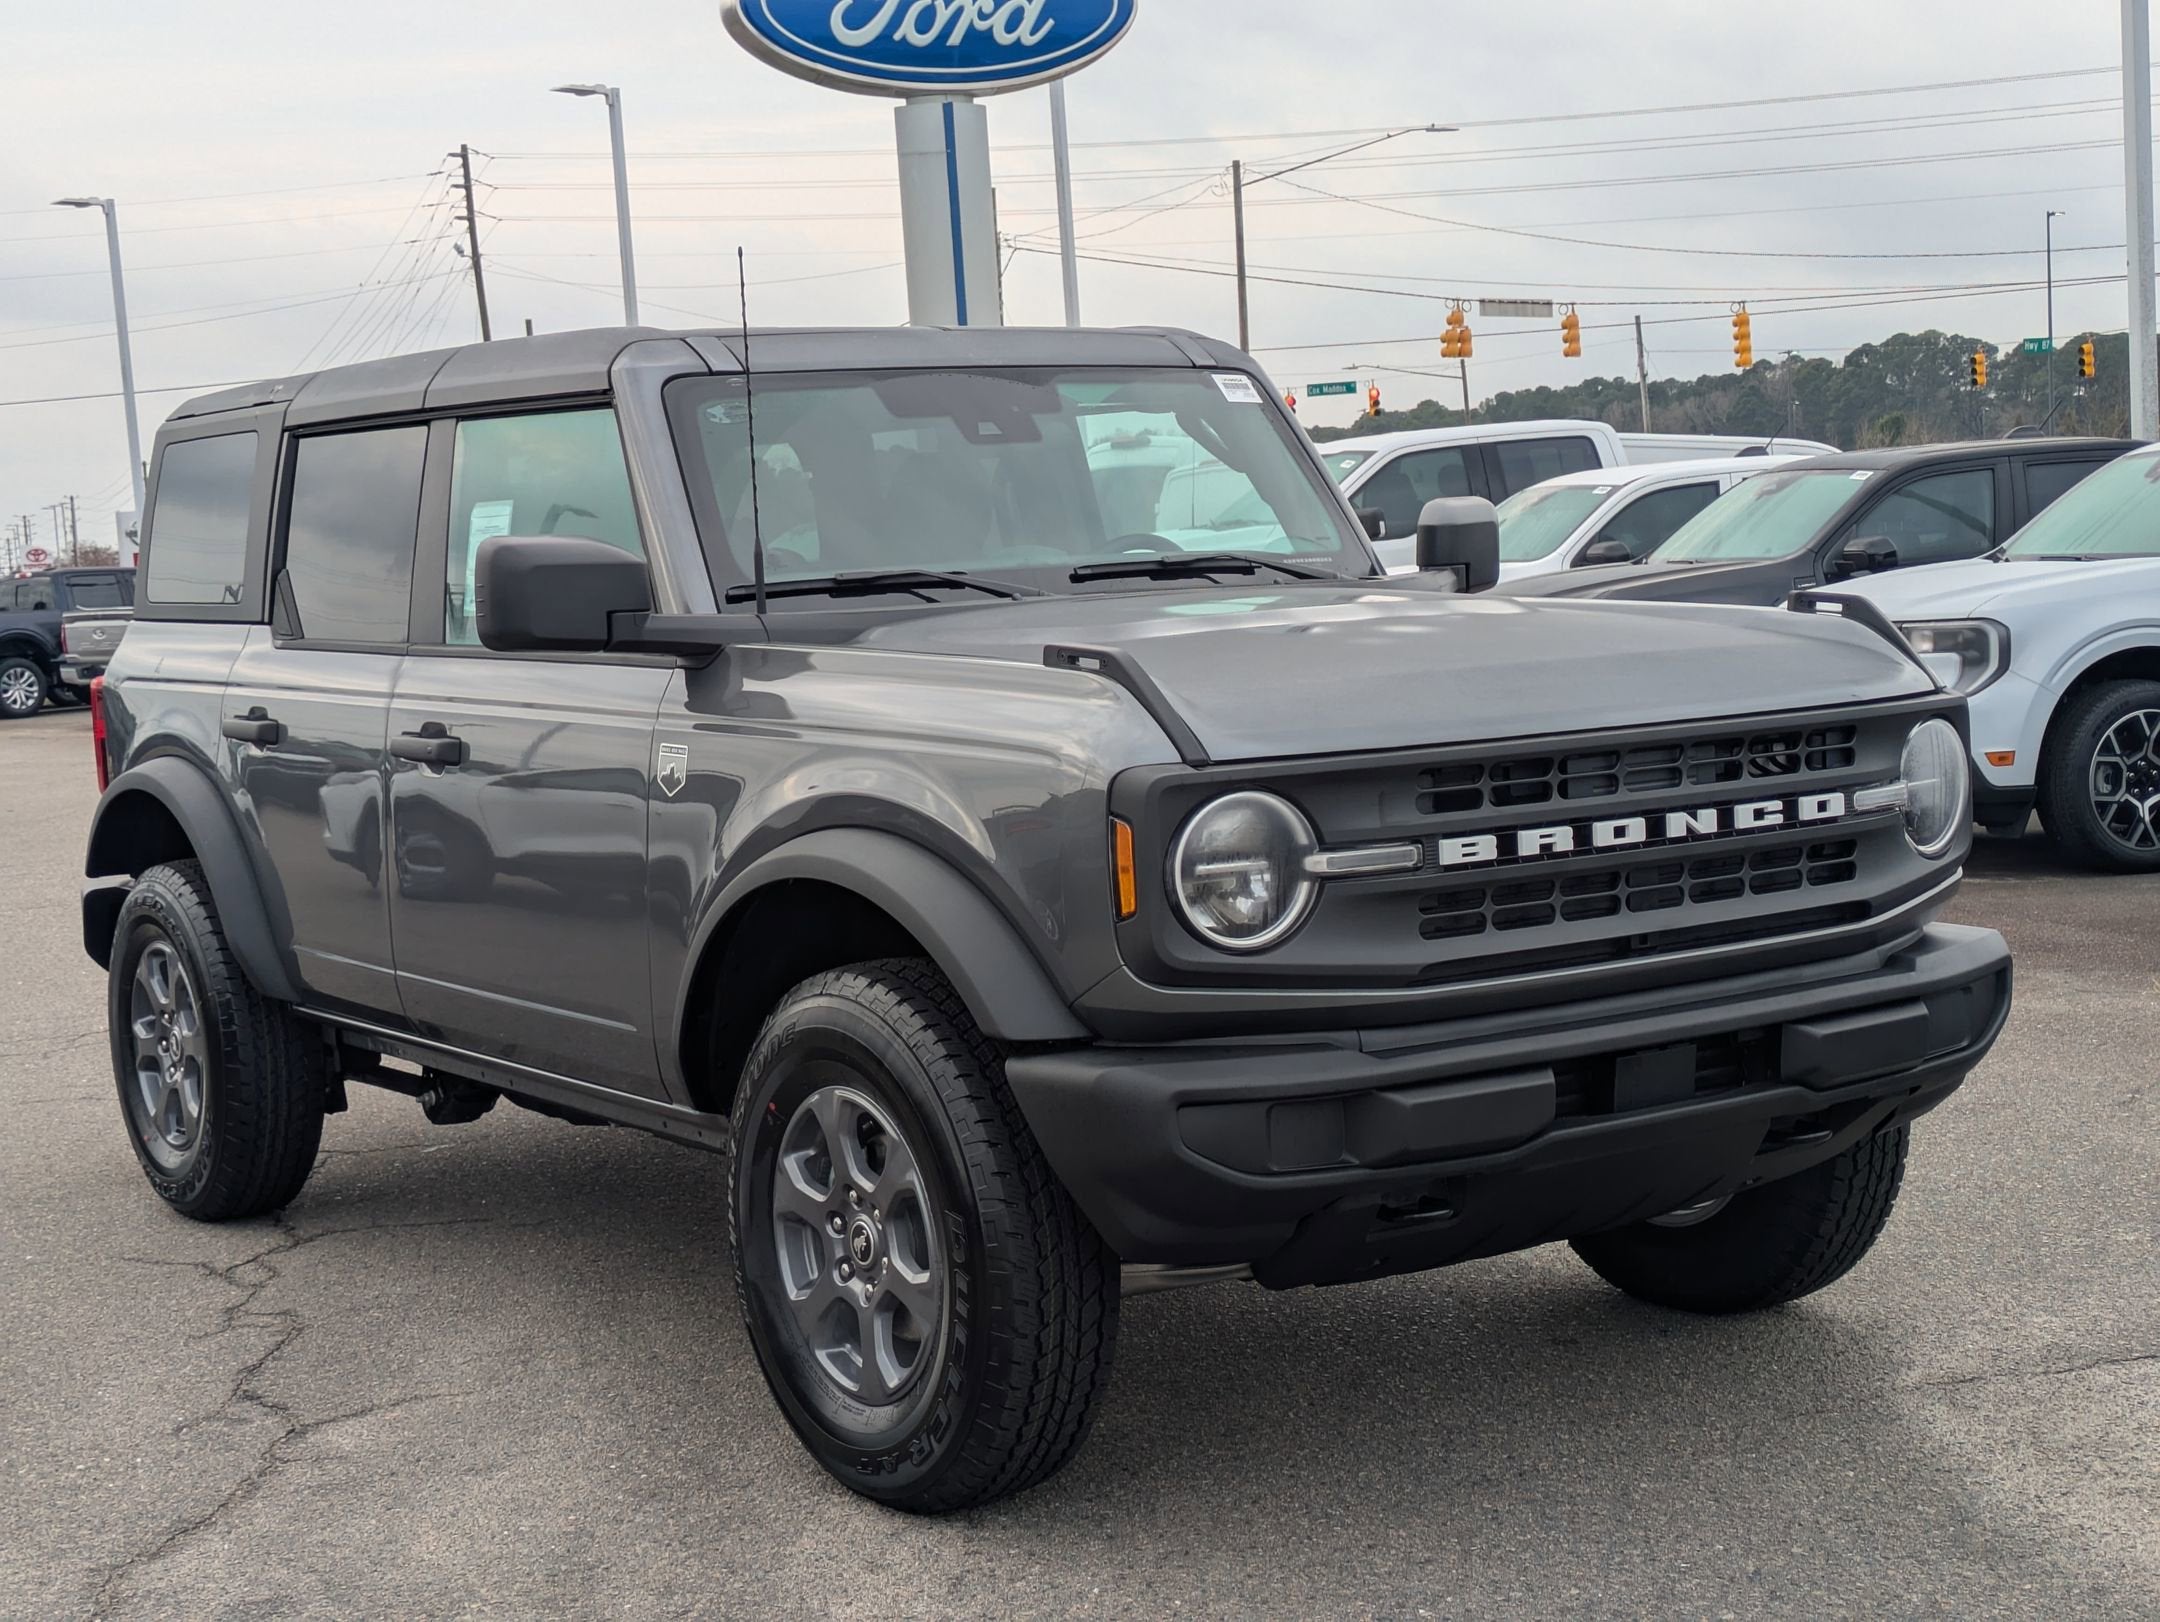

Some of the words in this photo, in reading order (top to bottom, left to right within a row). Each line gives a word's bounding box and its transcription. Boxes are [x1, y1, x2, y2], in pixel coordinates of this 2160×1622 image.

[2024, 340, 2039, 351] Hwy
[1308, 385, 1321, 396] Cox
[1322, 383, 1347, 394] Maddox
[1438, 792, 1846, 866] BRONCO
